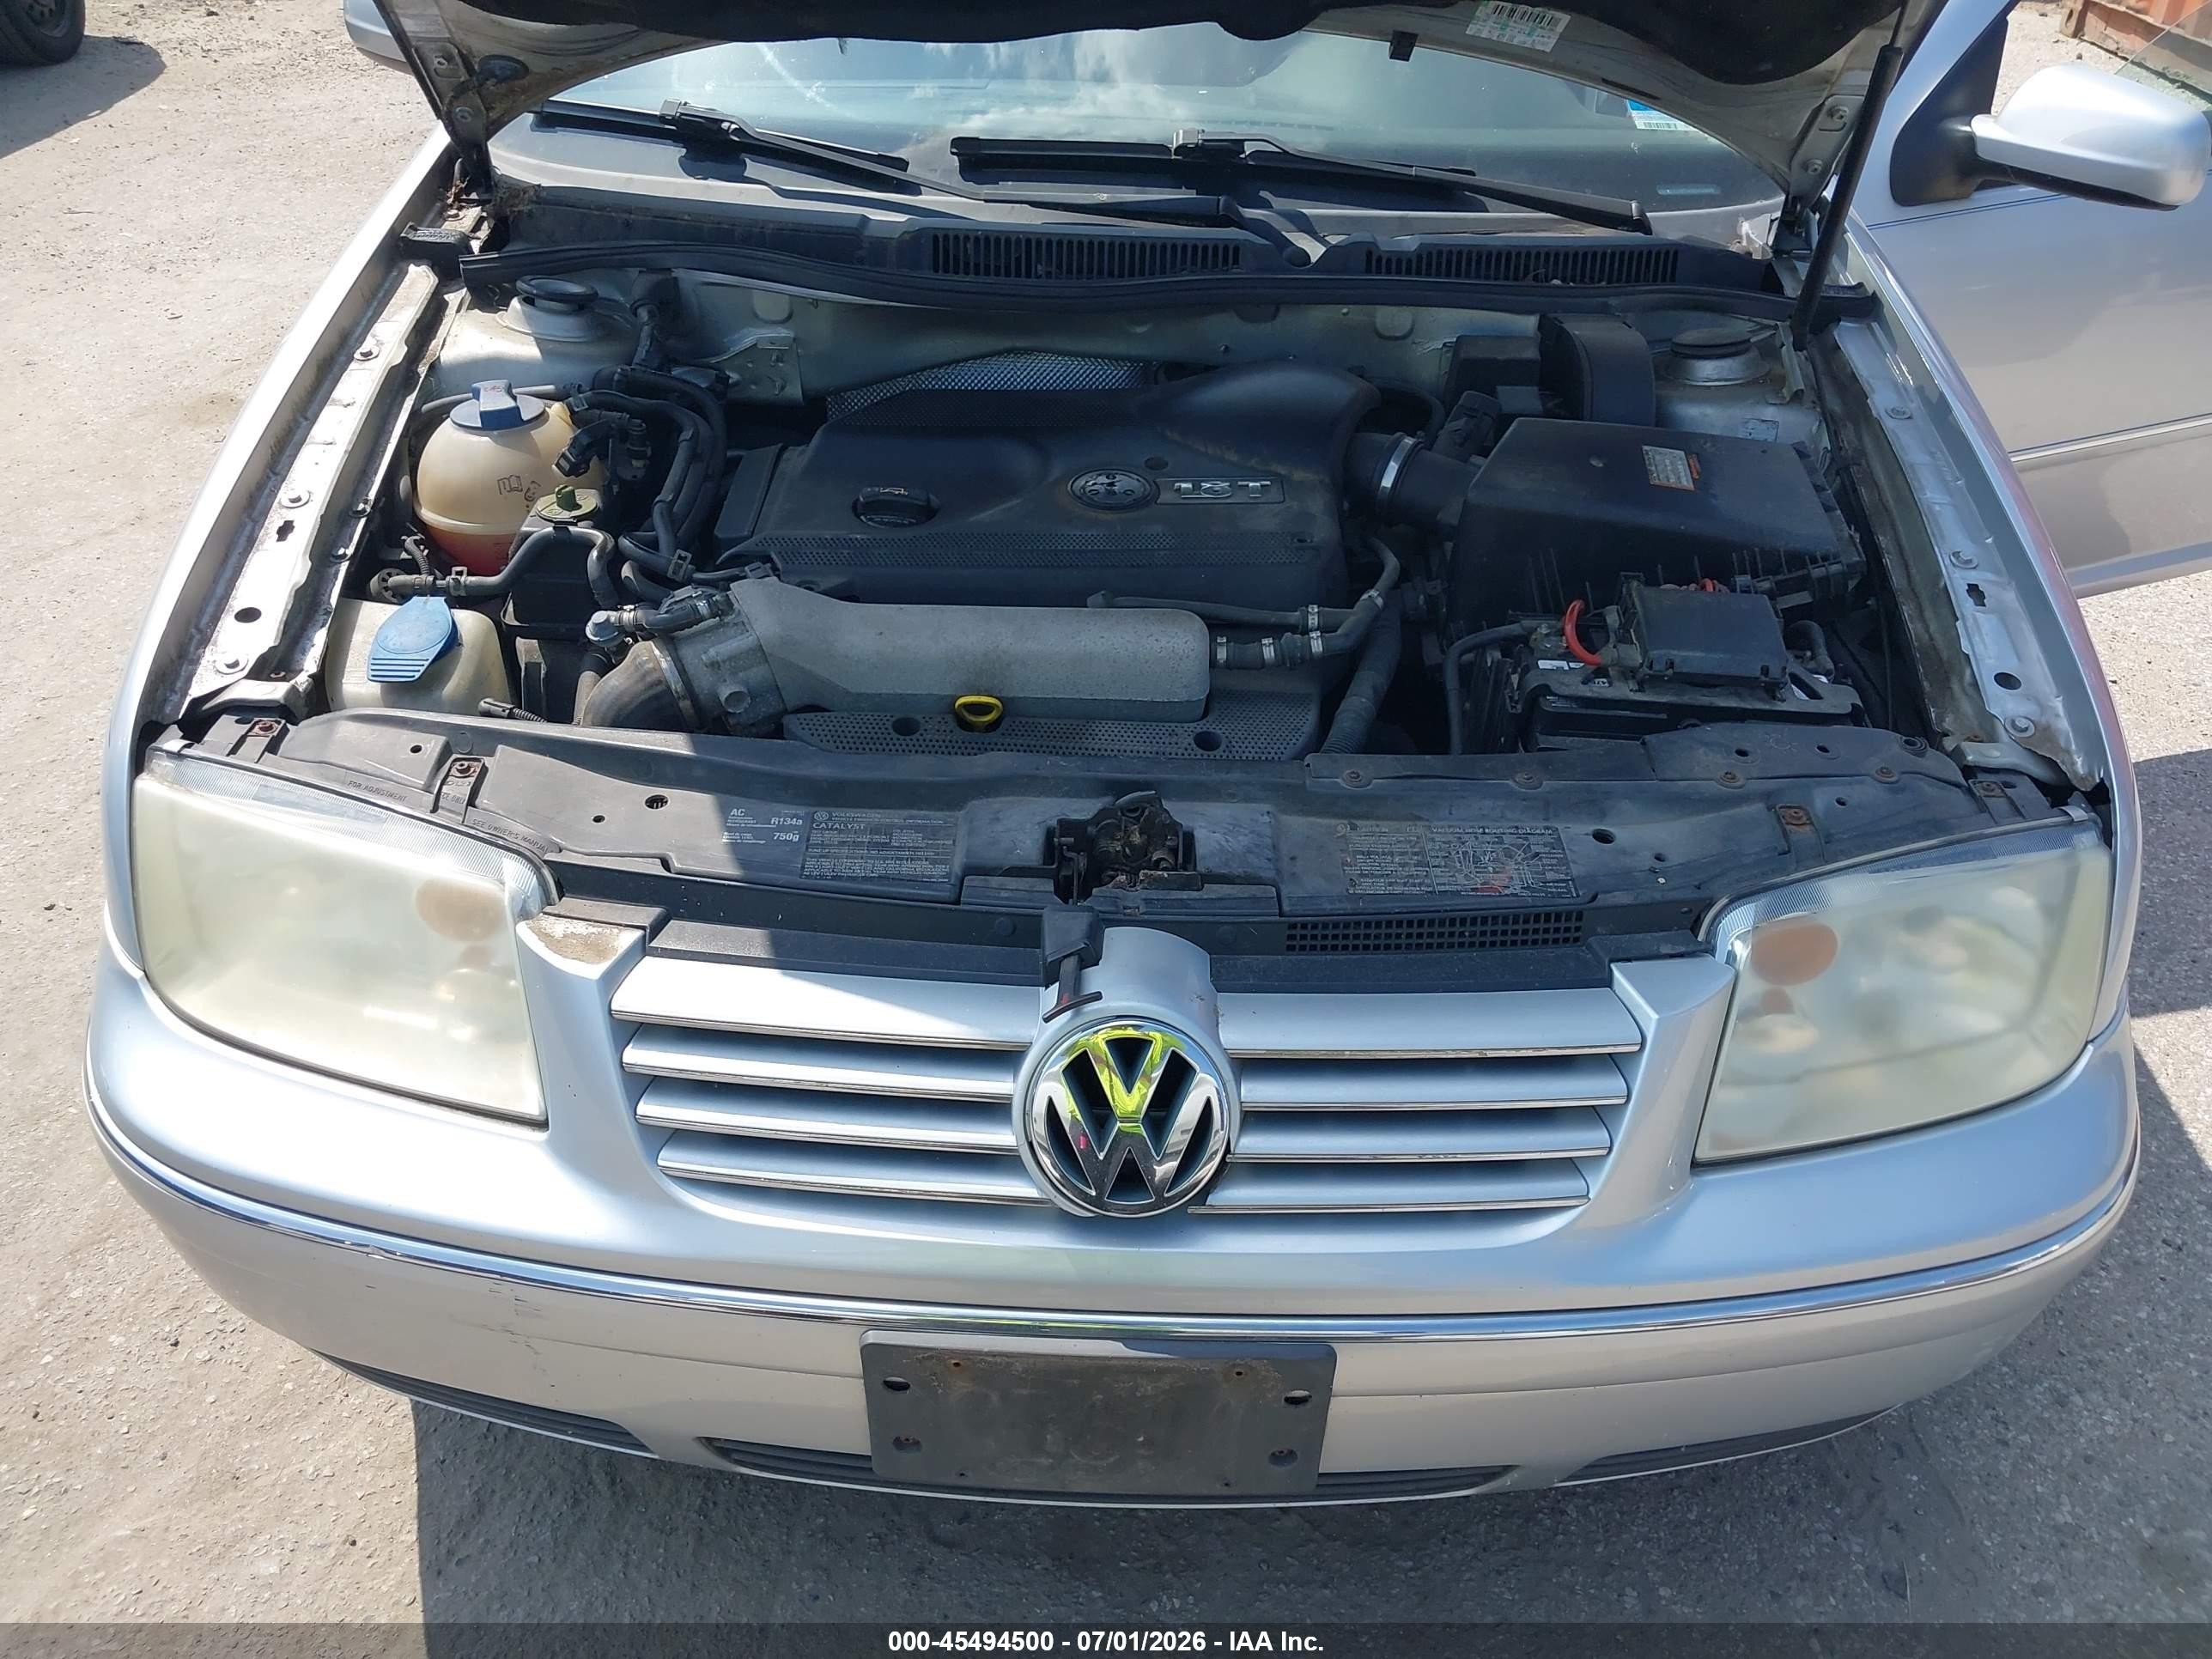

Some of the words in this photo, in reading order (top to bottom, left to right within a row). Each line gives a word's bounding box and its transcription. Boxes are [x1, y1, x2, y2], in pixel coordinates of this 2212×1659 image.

[729, 808, 746, 817] AC
[770, 817, 804, 826] R134a
[471, 818, 487, 829] SEE
[520, 836, 550, 853] MANUAL
[773, 830, 800, 842] 750g
